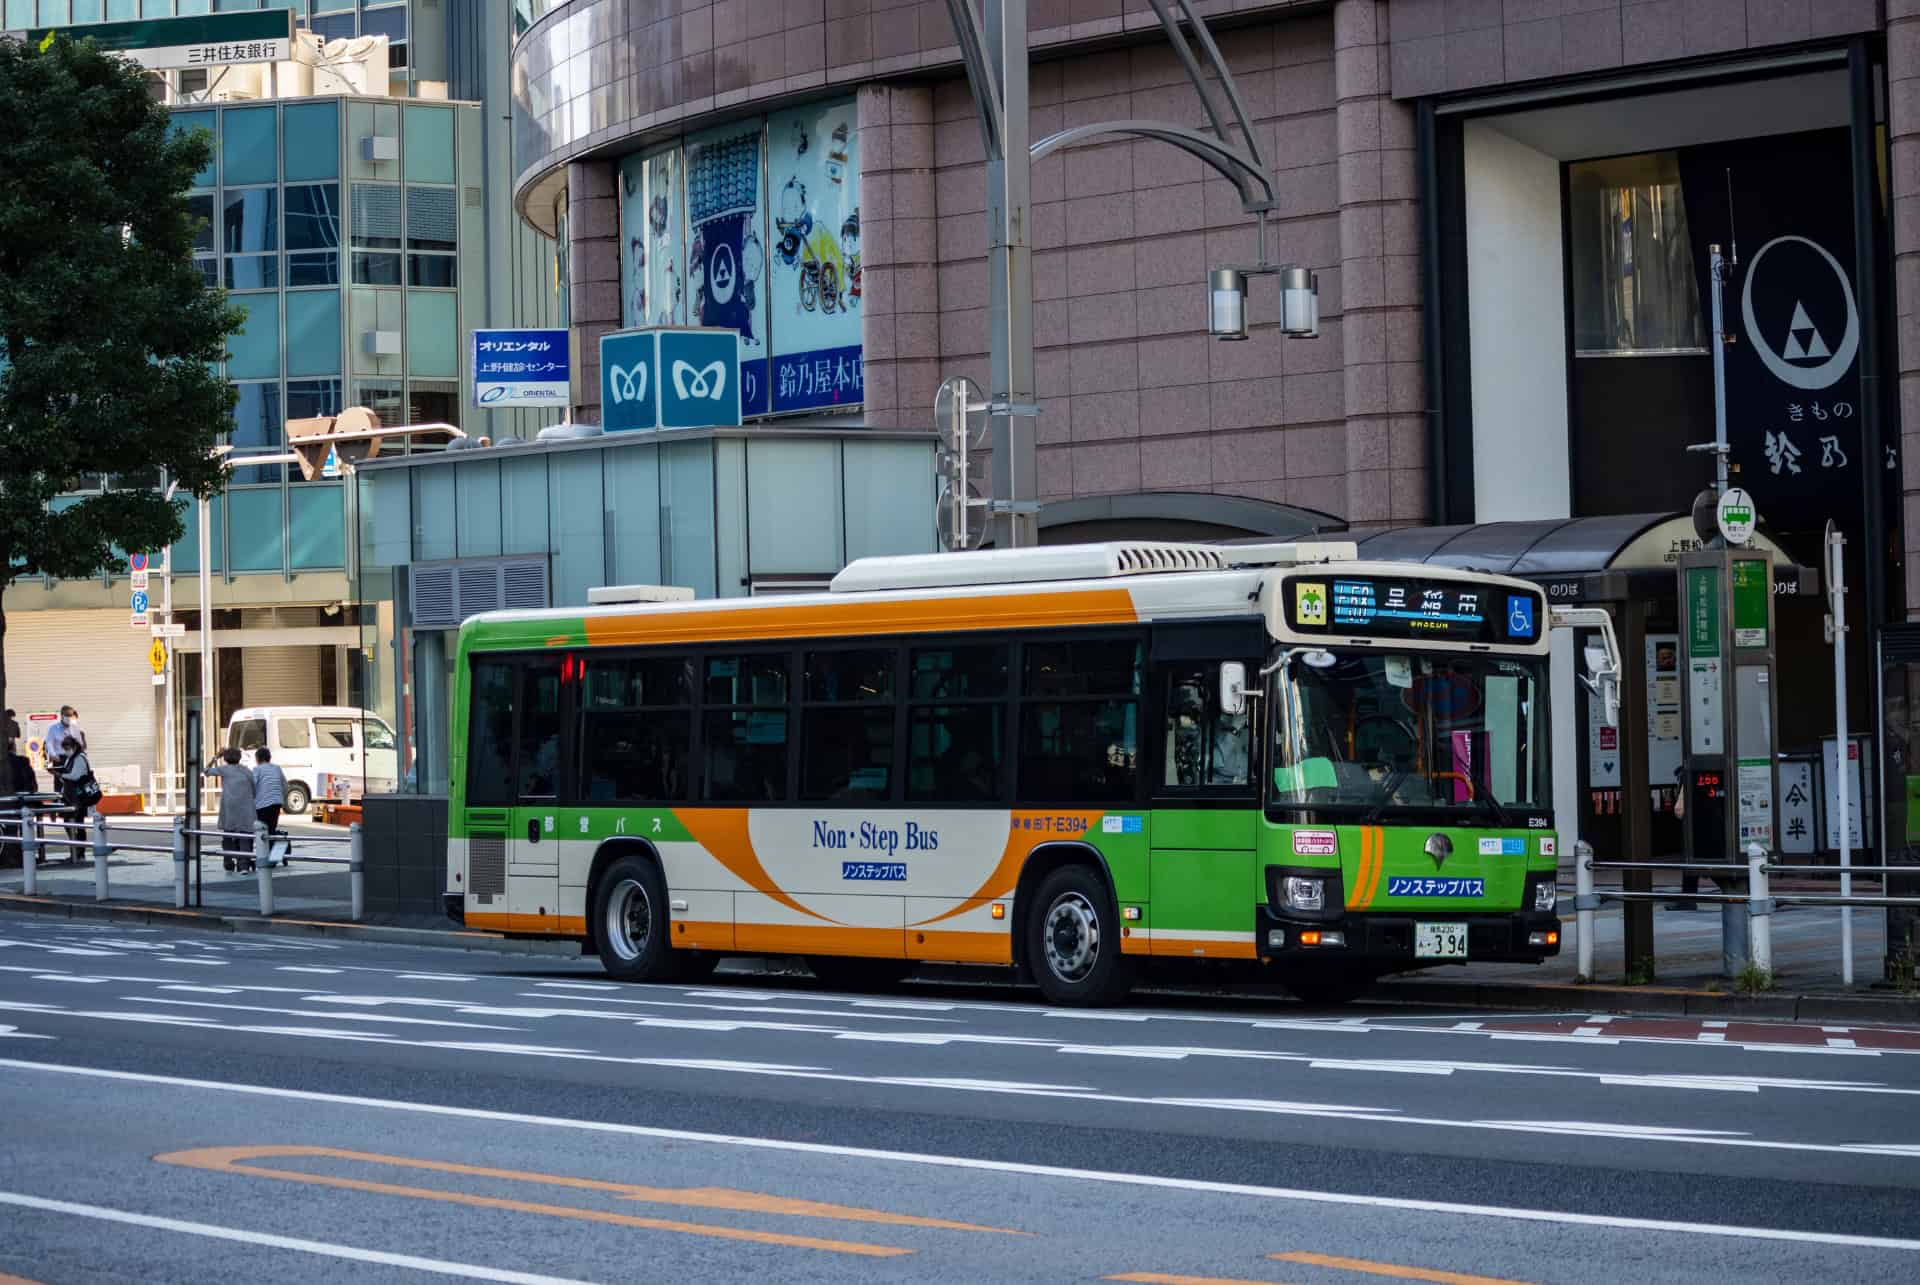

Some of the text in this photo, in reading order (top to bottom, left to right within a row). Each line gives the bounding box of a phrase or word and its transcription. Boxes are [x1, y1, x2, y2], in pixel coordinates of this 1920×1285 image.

[187, 42, 277, 63] 三井住友銀行
[480, 341, 551, 352] オリエンタル
[1788, 401, 1853, 421] きもの
[1733, 490, 1742, 506] 7
[1785, 784, 1808, 840] 今半
[1528, 818, 1547, 828] E394
[905, 821, 938, 850] Bus
[844, 864, 906, 879] ノンステップバス
[1389, 880, 1483, 895] ノンステップバス
